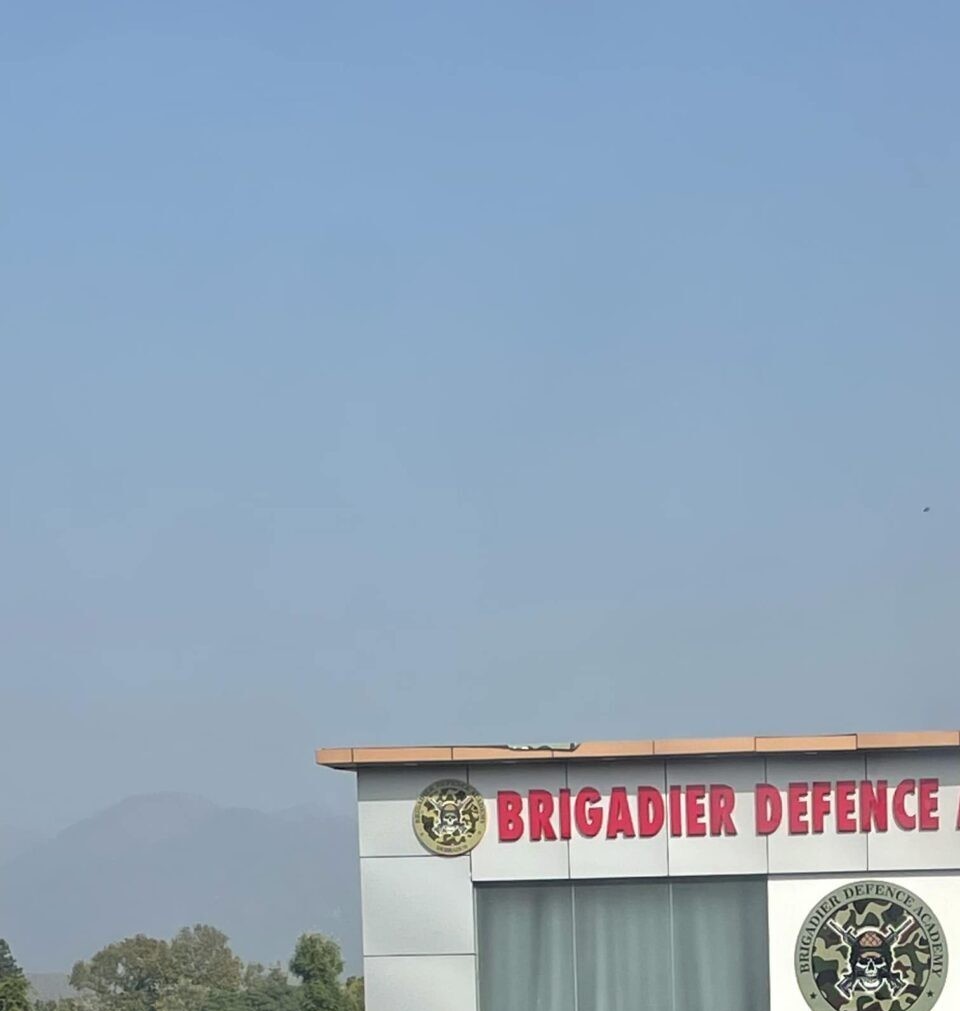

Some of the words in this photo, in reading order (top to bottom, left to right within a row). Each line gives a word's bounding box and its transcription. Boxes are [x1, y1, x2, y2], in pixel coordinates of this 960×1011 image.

[497, 784, 737, 842] BRIGADIER
[755, 778, 940, 836] DEFENCE
[800, 895, 841, 974] BRIGADIER
[843, 884, 913, 908] DEFENCE
[913, 905, 943, 978] ACADEMY
